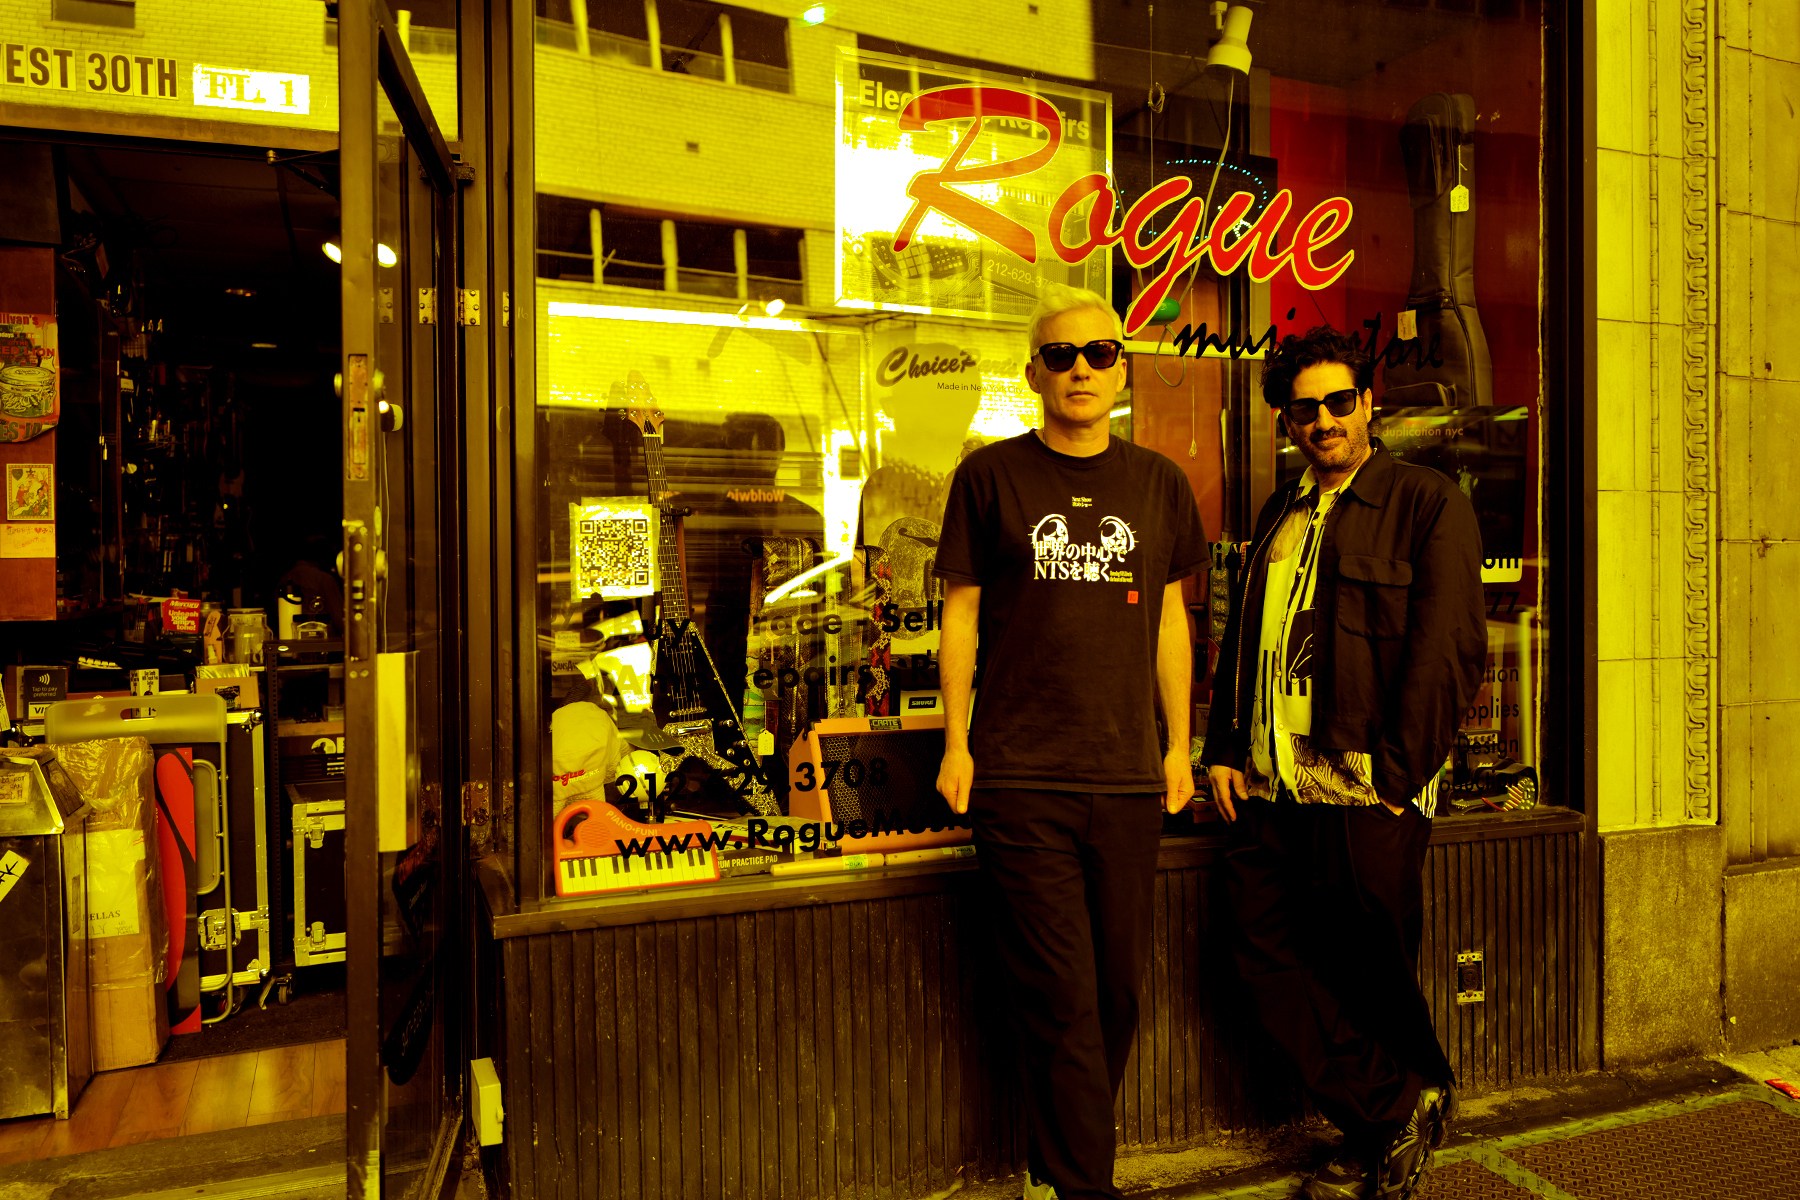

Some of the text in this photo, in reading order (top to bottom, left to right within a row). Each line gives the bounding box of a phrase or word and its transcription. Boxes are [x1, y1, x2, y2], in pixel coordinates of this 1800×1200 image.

[0, 43, 176, 98] EST 30TH
[279, 79, 298, 107] 1
[893, 84, 1355, 336] Rogue
[0, 347, 20, 356] ED
[937, 382, 1024, 395] Made in New York City
[1382, 426, 1464, 440] duplication nyc
[168, 610, 199, 618] Unleash
[32, 686, 42, 694] Tap
[1465, 696, 1520, 727] pplies
[872, 719, 900, 728] CRATE
[1458, 735, 1519, 760] Design
[552, 769, 586, 787] ogue
[731, 856, 764, 868] PRACTICE
[765, 854, 778, 864] PAD
[89, 910, 121, 921] ELLAS
